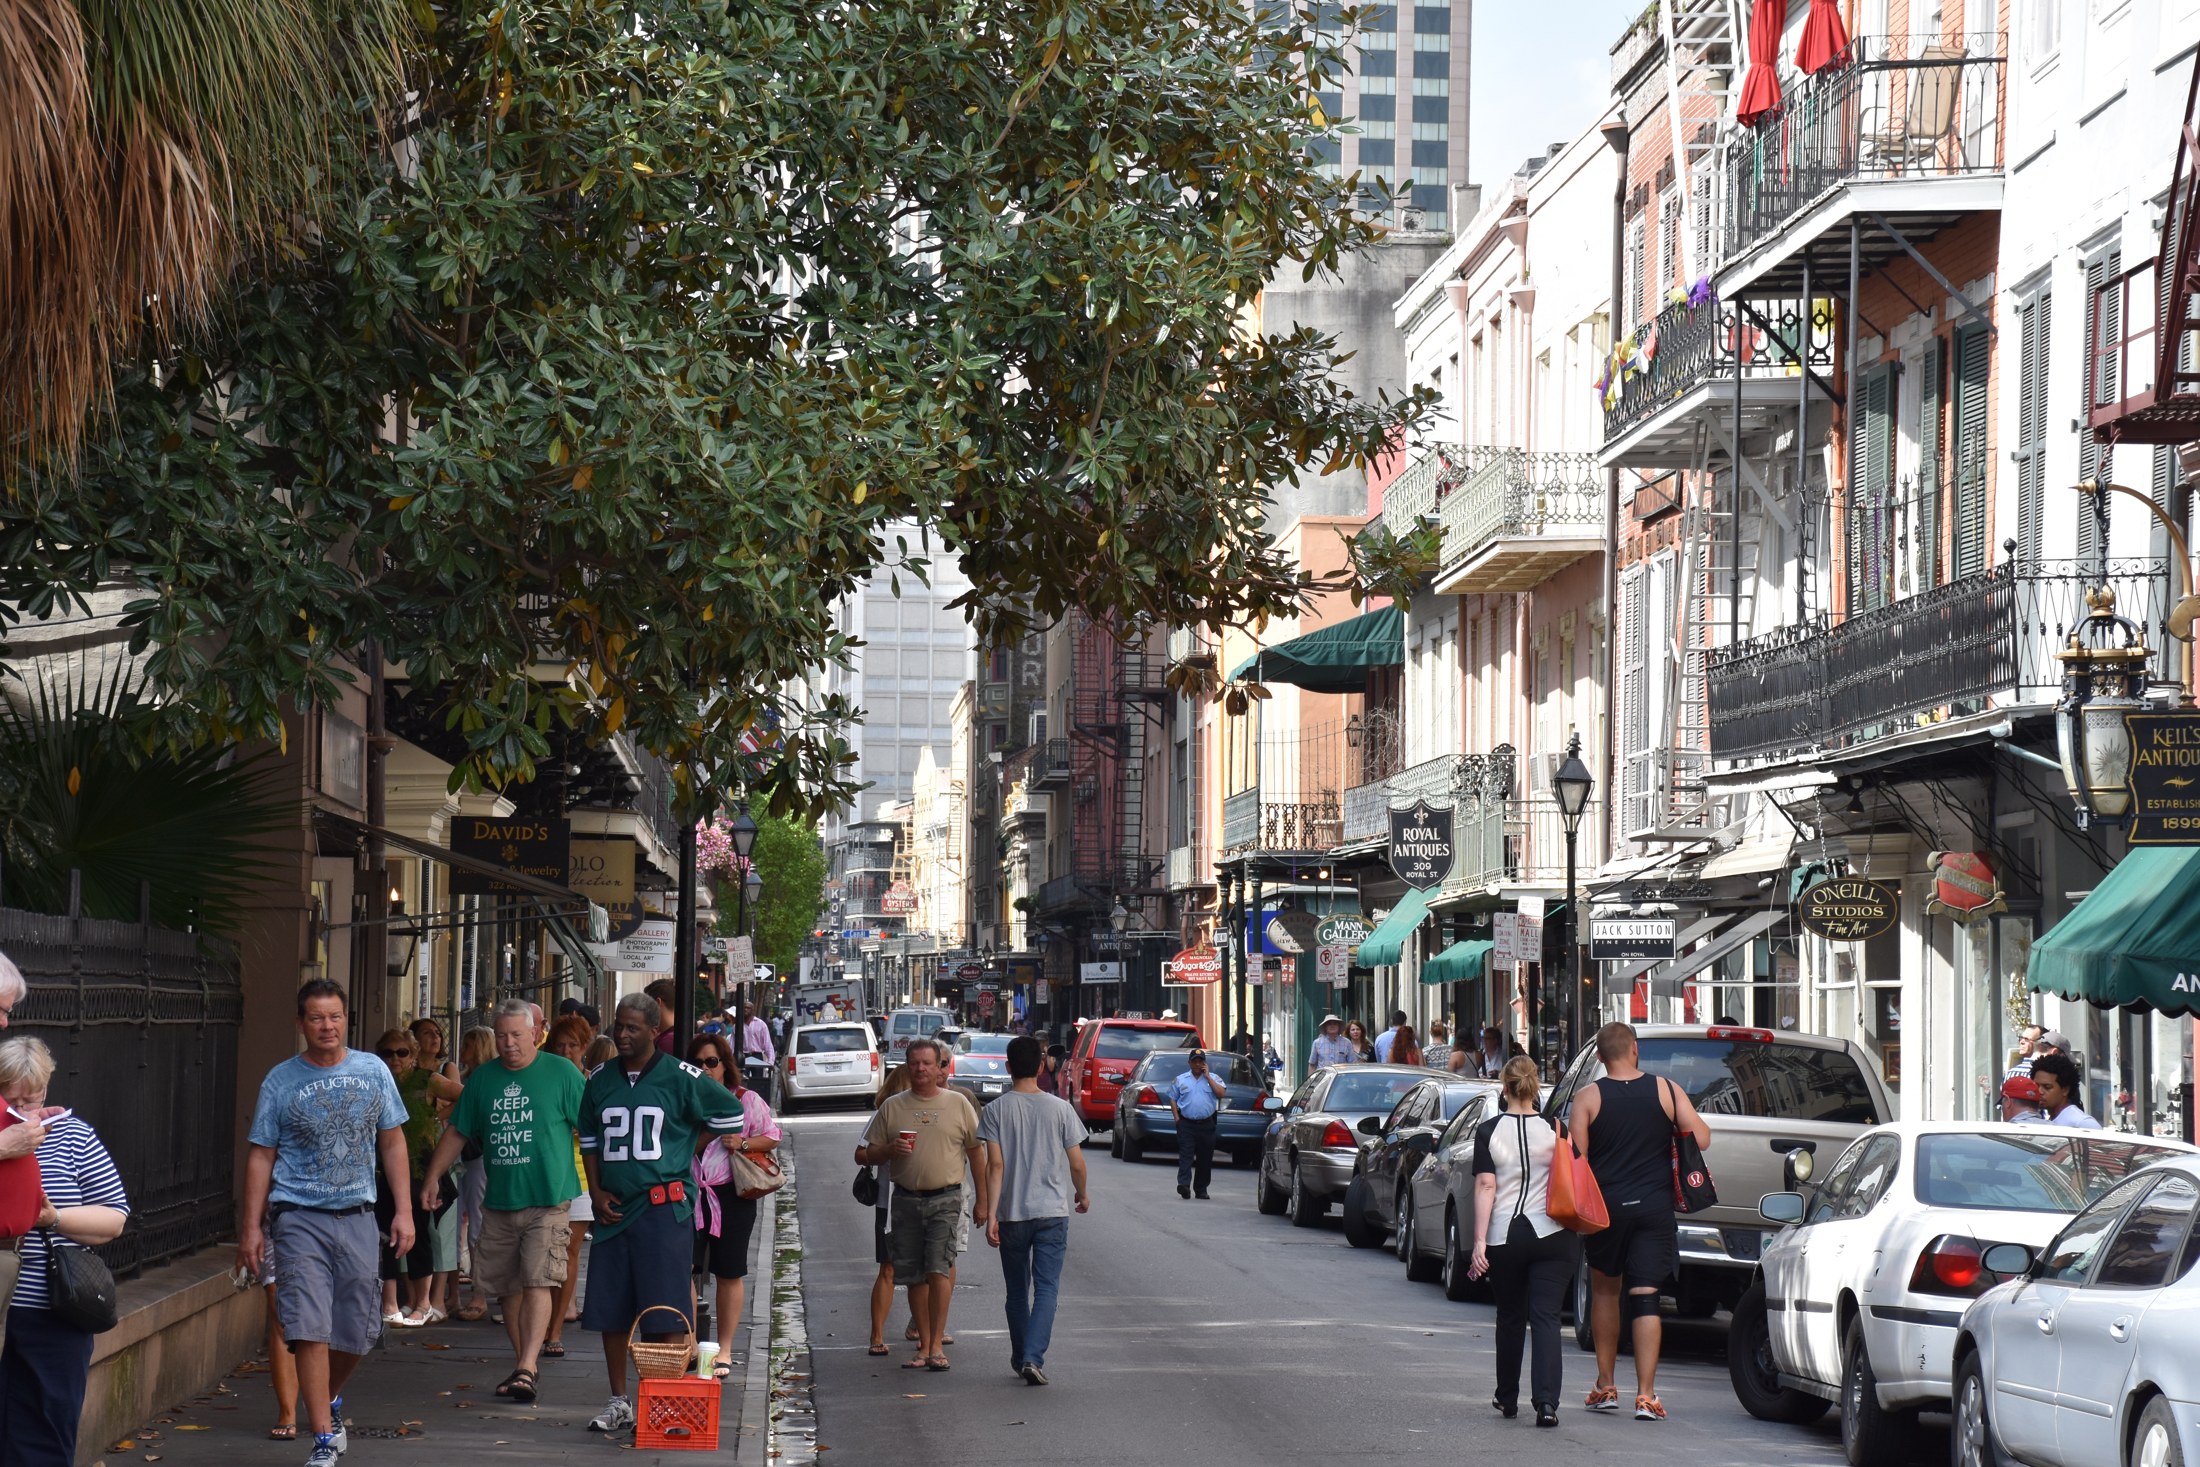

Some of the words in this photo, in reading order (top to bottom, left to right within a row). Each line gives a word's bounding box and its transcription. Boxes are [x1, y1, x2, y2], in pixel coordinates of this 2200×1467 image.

[2153, 726, 2200, 747] KEIL'S
[2163, 817, 2200, 829] 1899
[474, 822, 548, 840] DAVID'S
[1403, 828, 1440, 842] ROYAL
[1394, 844, 1450, 860] ANTIQUES
[520, 865, 560, 878] Jewelry
[1413, 862, 1432, 870] 309
[1812, 884, 1880, 904] O'NEILL
[1812, 906, 1884, 917] STUDIOS
[1335, 921, 1363, 930] MANN
[1596, 925, 1622, 936] JACK
[1628, 925, 1670, 936] SUTTON
[1822, 920, 1848, 936] Fine
[1848, 921, 1869, 937] Art
[1323, 929, 1371, 940] GALLERY
[1520, 929, 1538, 937] MALL
[493, 1096, 529, 1110] KEEP
[490, 1110, 533, 1124] CALM
[490, 1130, 533, 1144] CHIVE
[602, 1106, 665, 1161] 20
[498, 1145, 520, 1157] ON
[502, 1156, 530, 1166] ORLEANS
